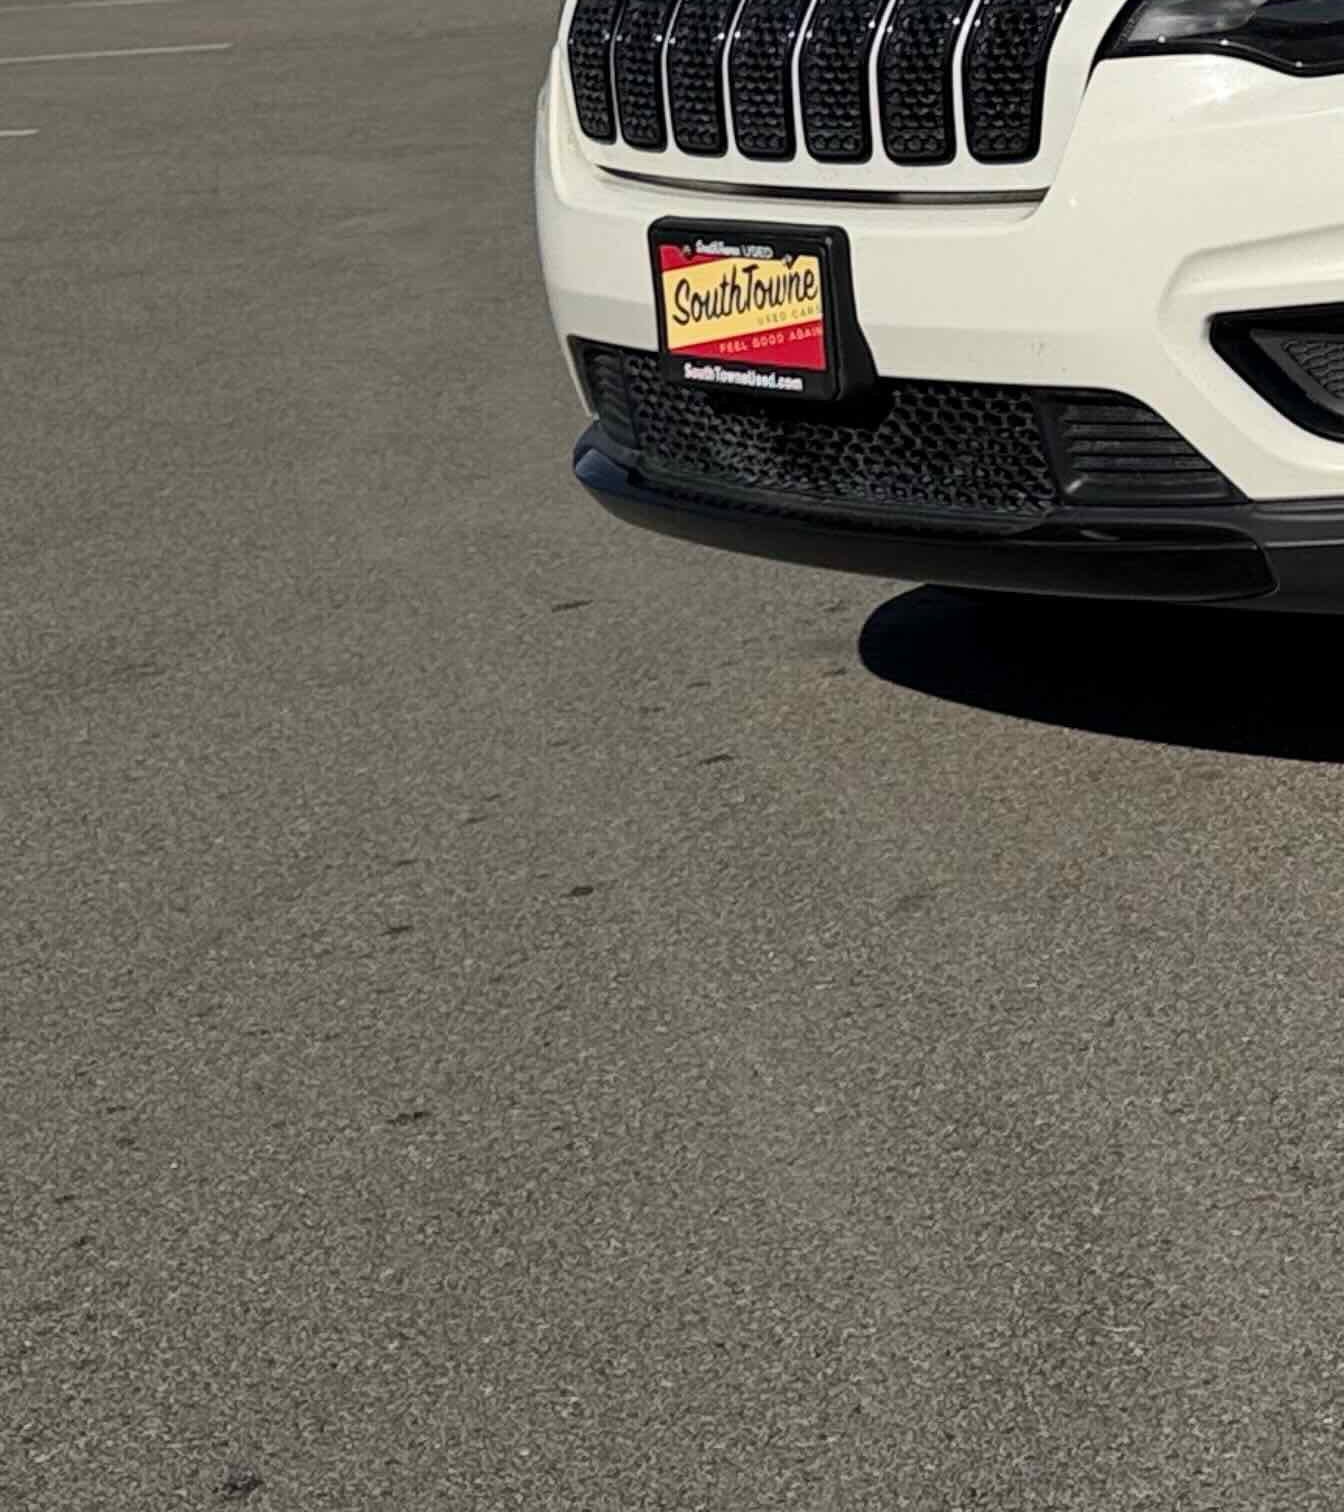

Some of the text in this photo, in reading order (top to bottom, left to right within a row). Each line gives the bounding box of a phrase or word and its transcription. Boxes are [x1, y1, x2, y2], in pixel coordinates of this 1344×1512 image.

[672, 264, 818, 326] SouthTowne
[719, 341, 748, 354] FEEL
[752, 333, 785, 349] GOOD
